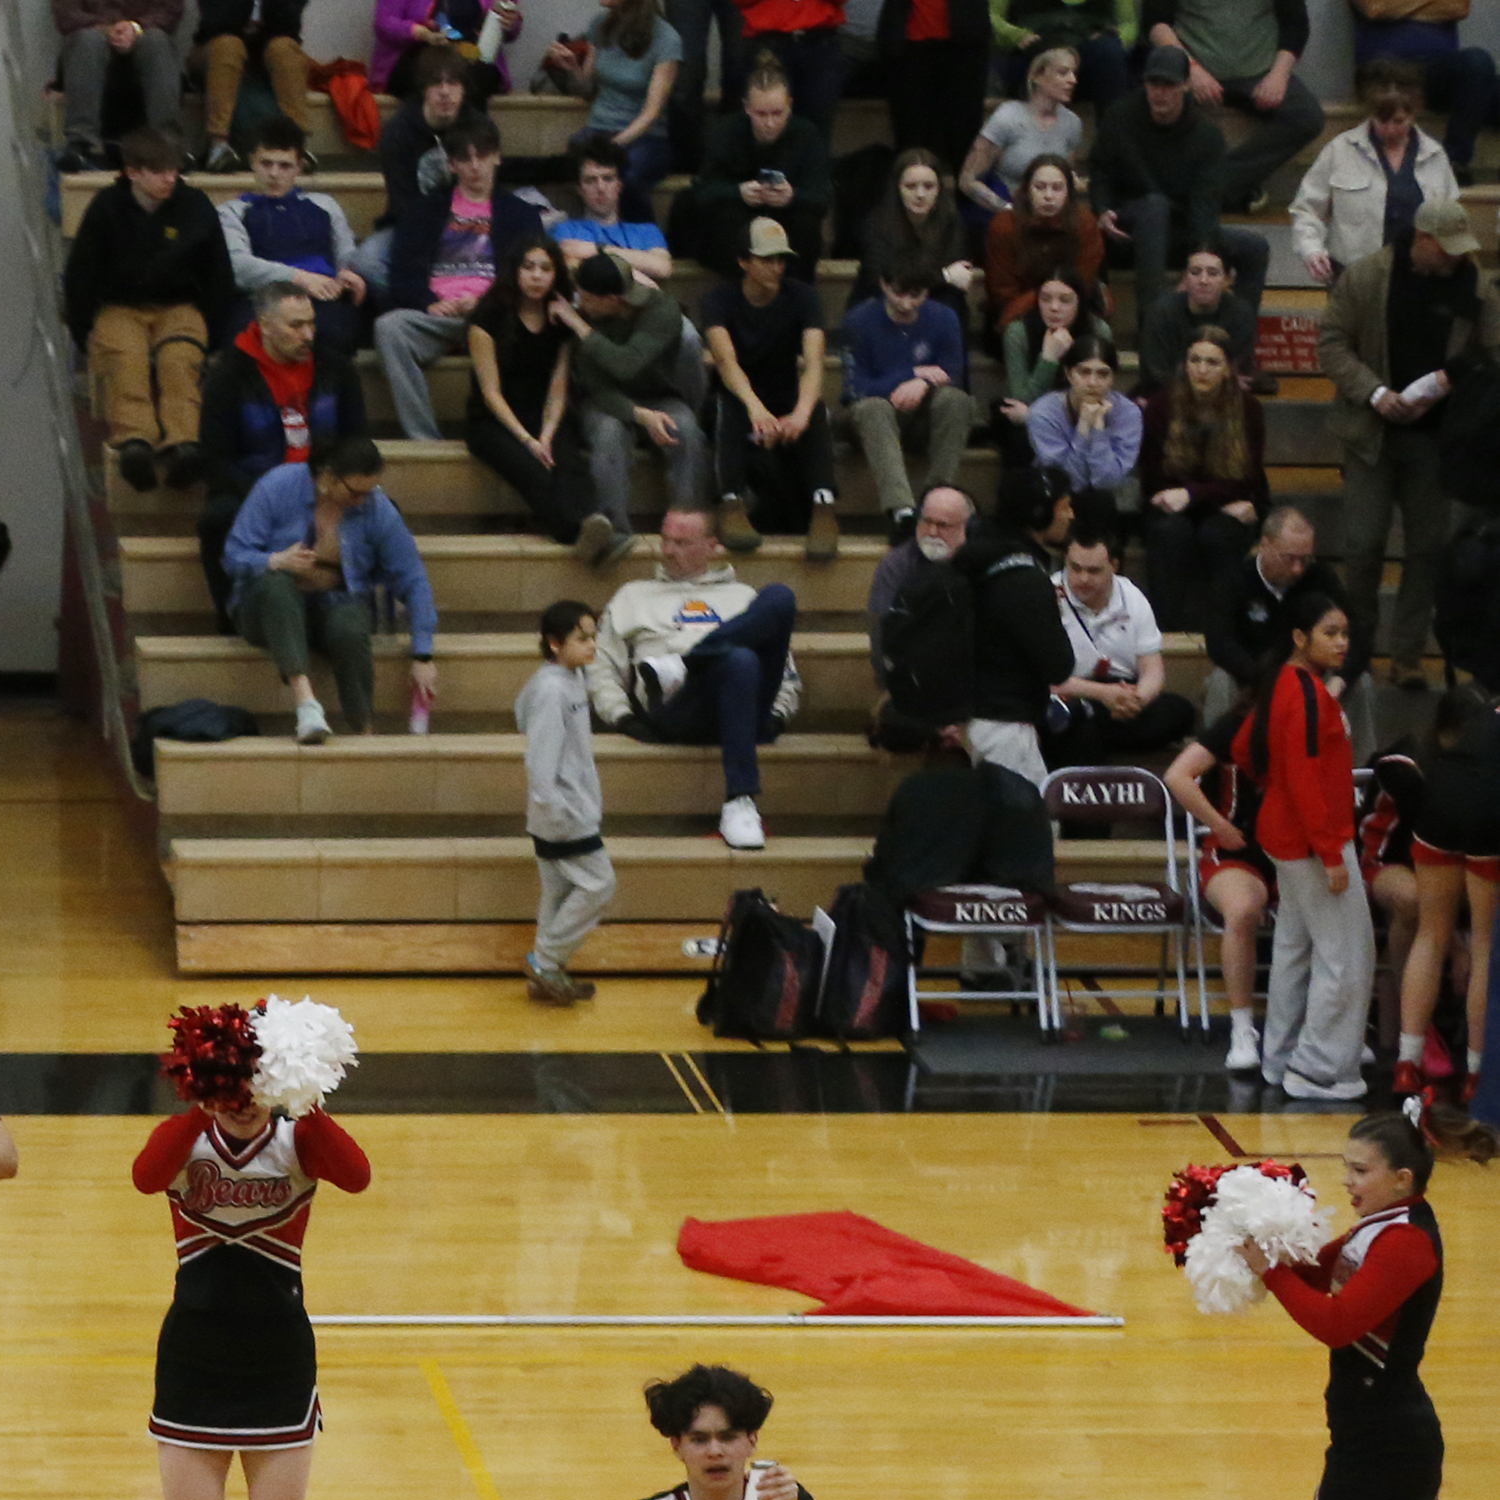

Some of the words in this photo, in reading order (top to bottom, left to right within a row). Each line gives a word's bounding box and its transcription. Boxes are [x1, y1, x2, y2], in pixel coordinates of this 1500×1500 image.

[1063, 782, 1146, 804] KAYHI
[955, 901, 1028, 922] KINGS
[1094, 901, 1168, 921] KINGS
[183, 1159, 292, 1213] Bears
